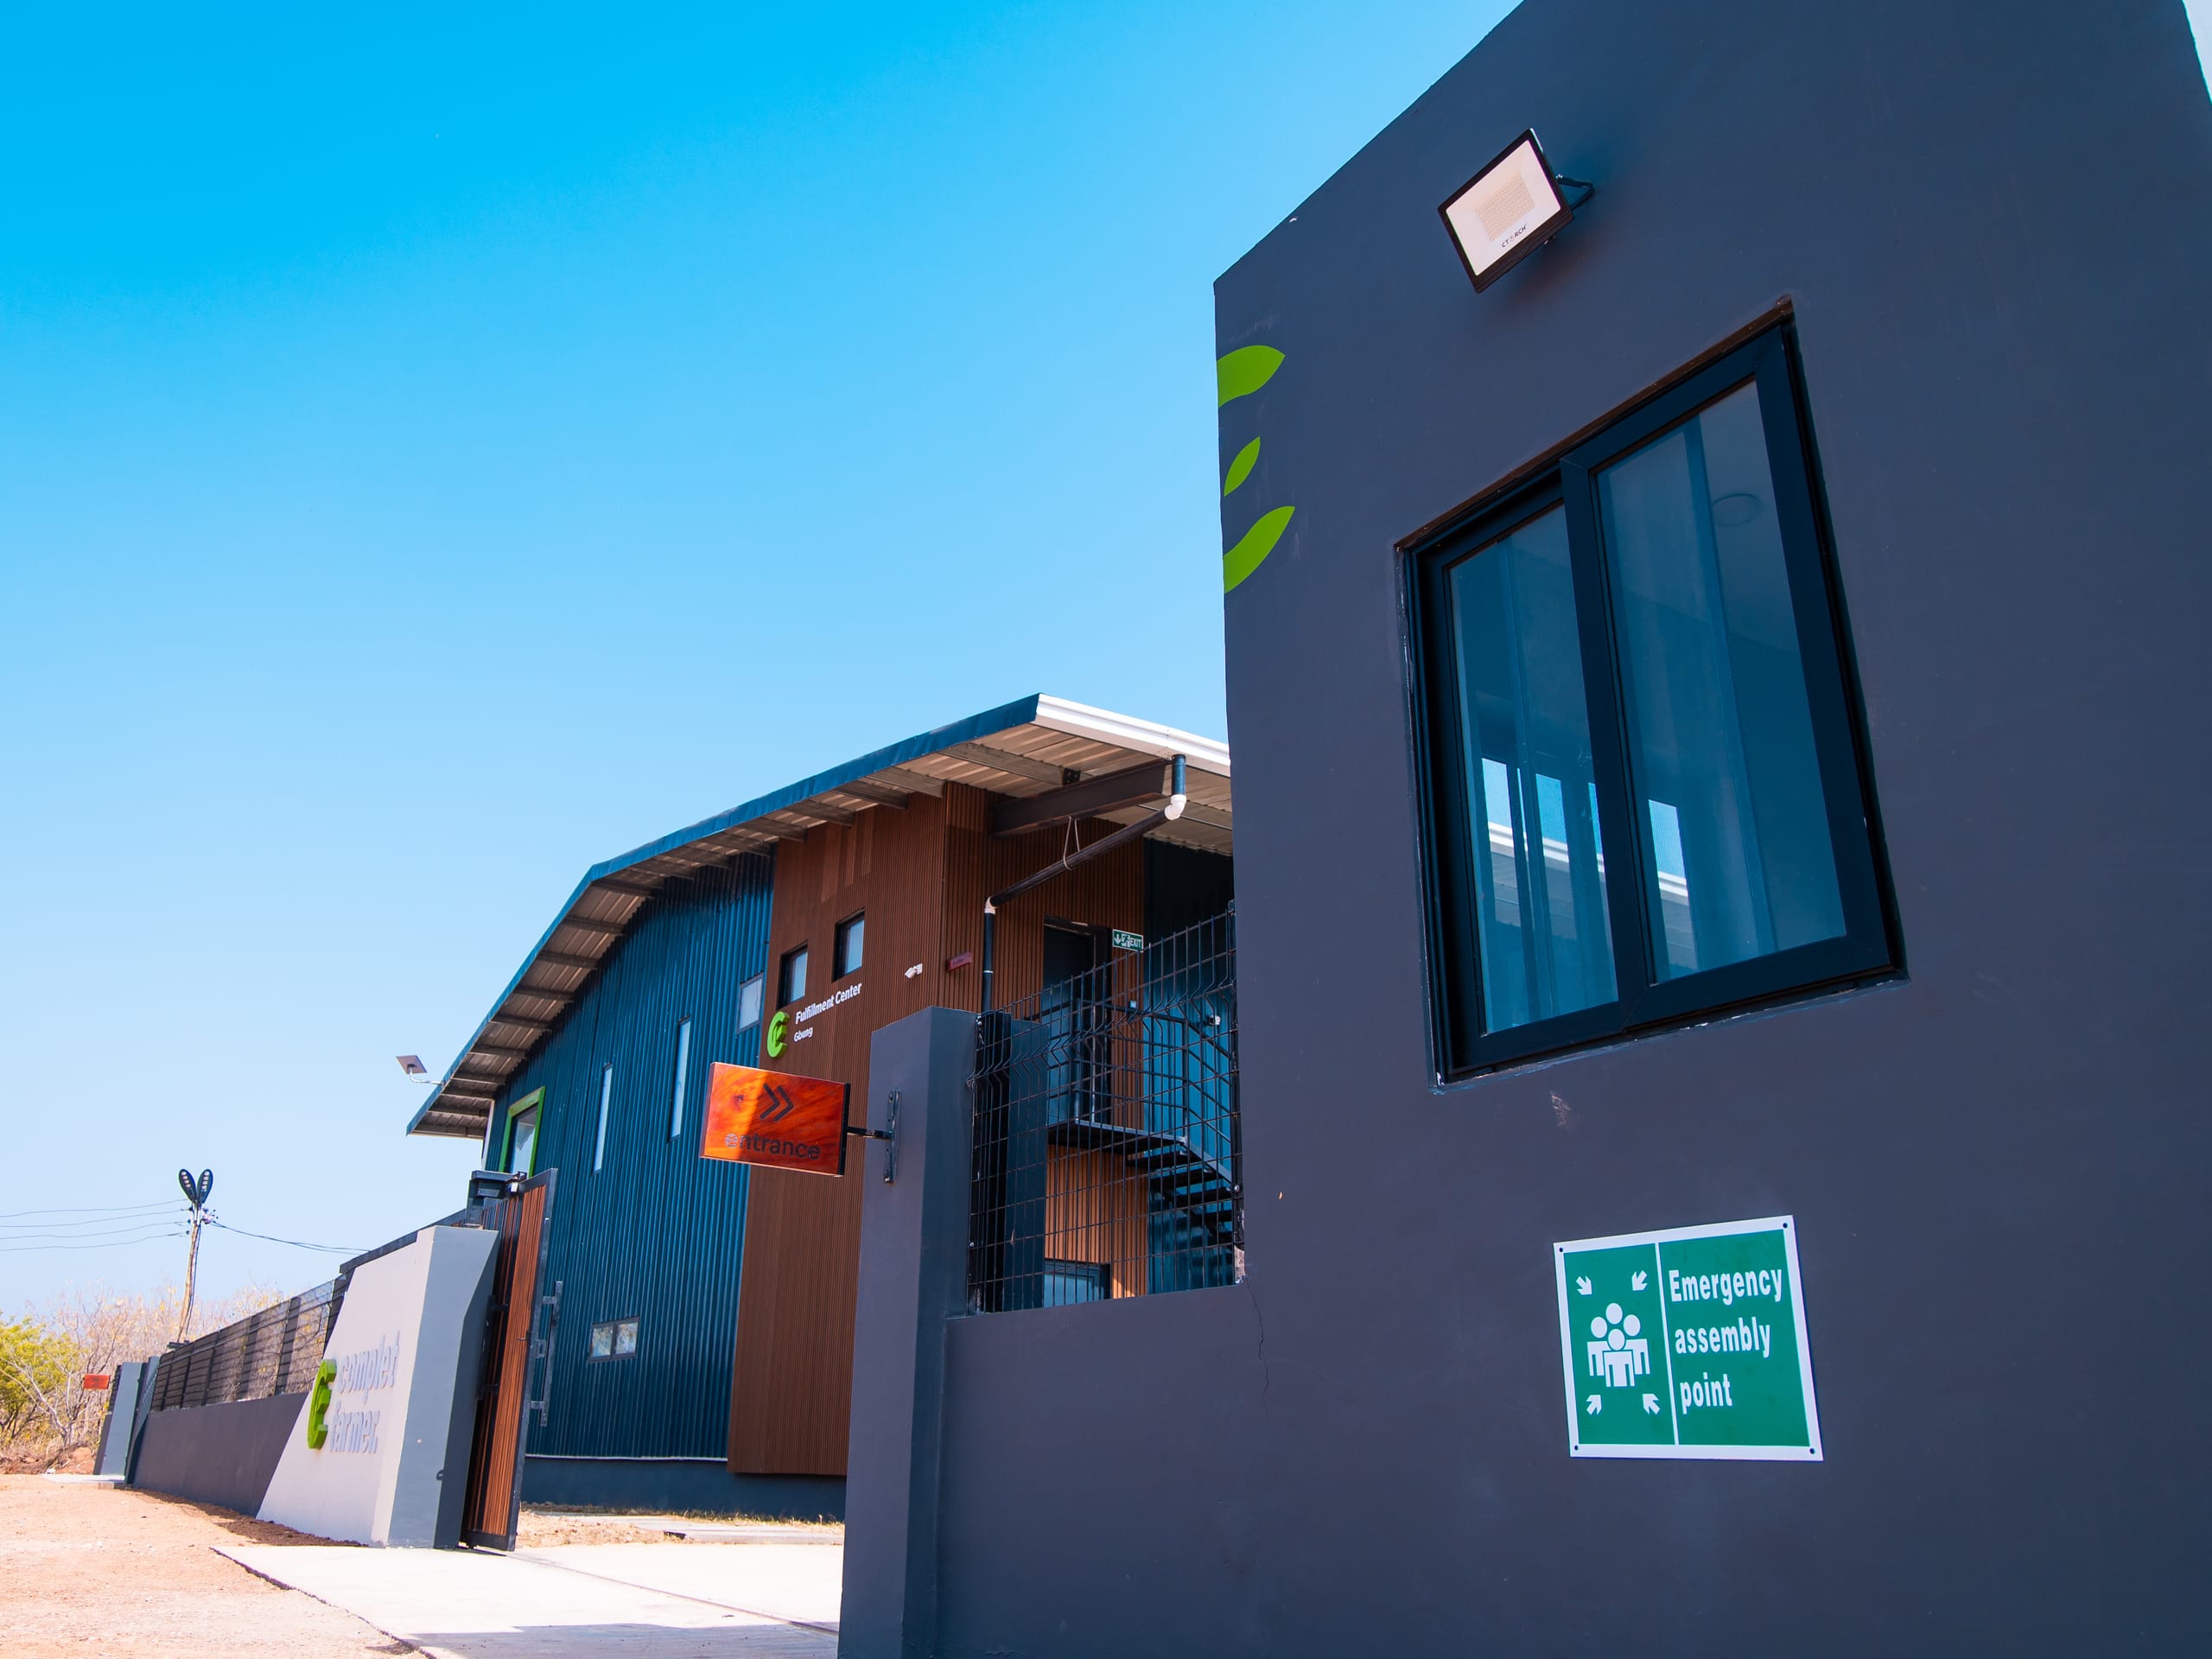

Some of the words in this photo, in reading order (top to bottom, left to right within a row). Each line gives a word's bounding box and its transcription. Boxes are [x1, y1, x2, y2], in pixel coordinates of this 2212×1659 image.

[1130, 938, 1142, 948] EXIT
[795, 995, 835, 1025] Fulfillment
[835, 982, 862, 1005] Center
[724, 1133, 821, 1160] entrance
[1669, 1269, 1783, 1306] Emergency
[1675, 1316, 1771, 1358] assembly
[1680, 1371, 1733, 1415] point
[330, 1400, 381, 1453] farmer
